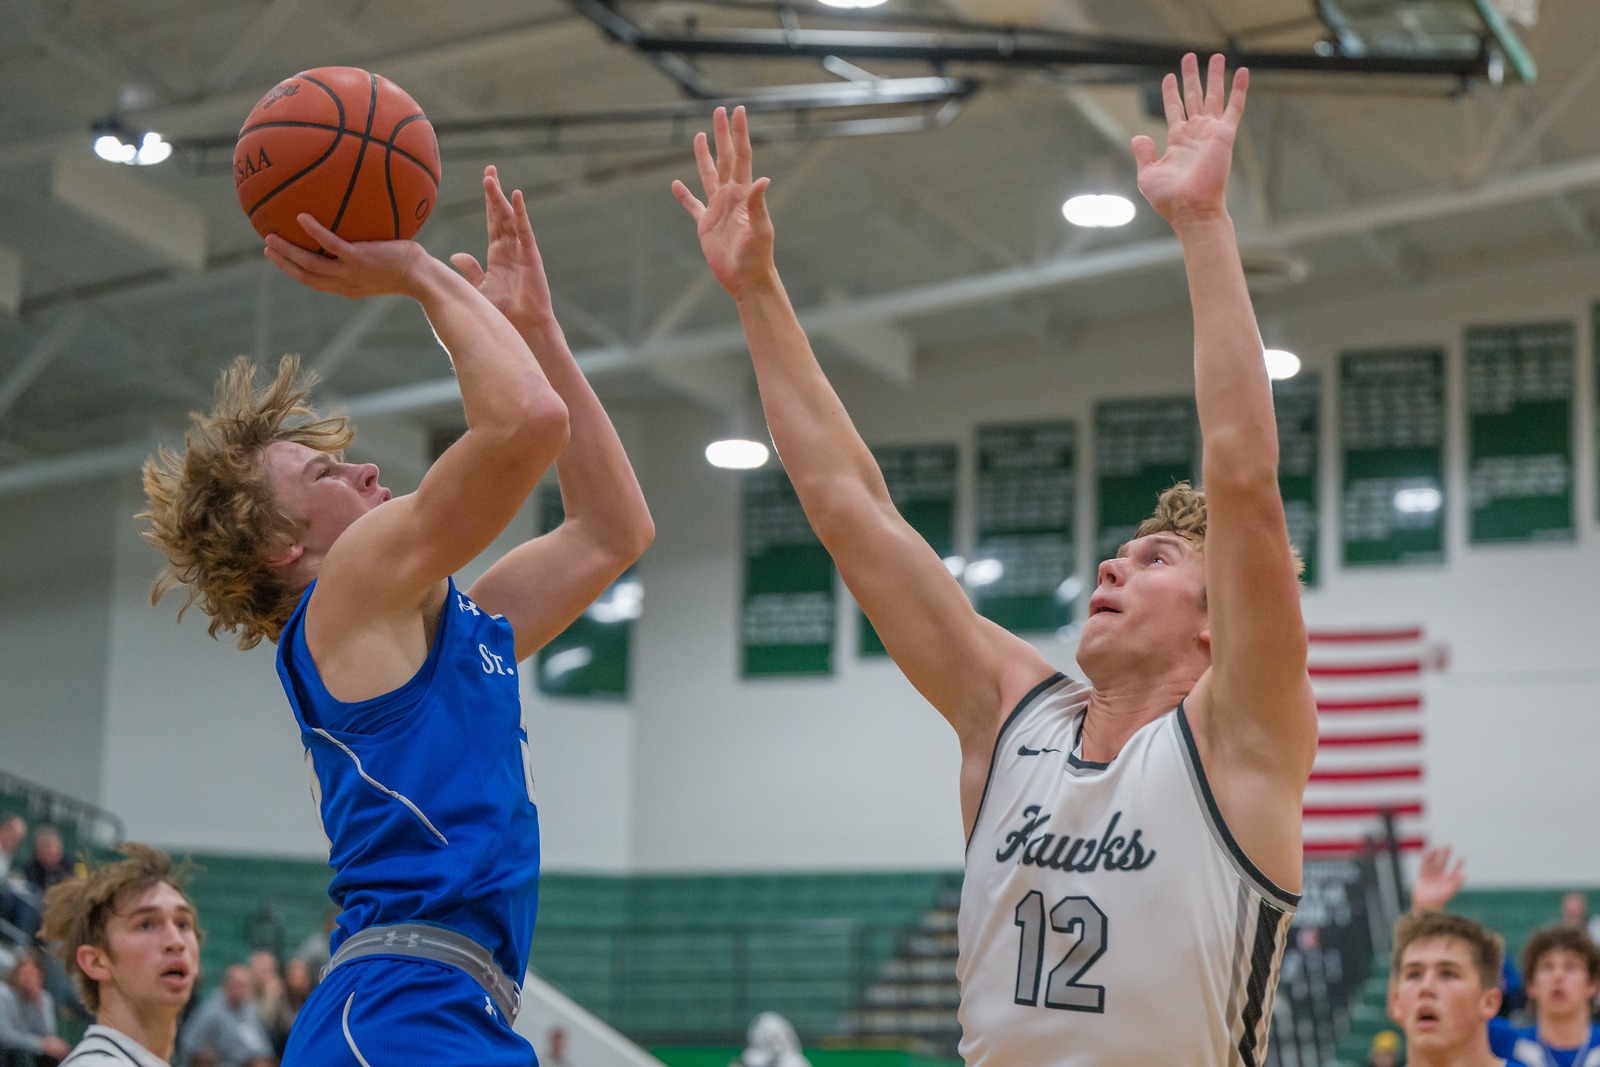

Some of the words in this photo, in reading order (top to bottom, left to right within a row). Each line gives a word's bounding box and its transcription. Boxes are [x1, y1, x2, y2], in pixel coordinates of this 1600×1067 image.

[234, 147, 274, 189] SAA
[996, 804, 1156, 873] Hawks
[1013, 889, 1109, 1014] 12
